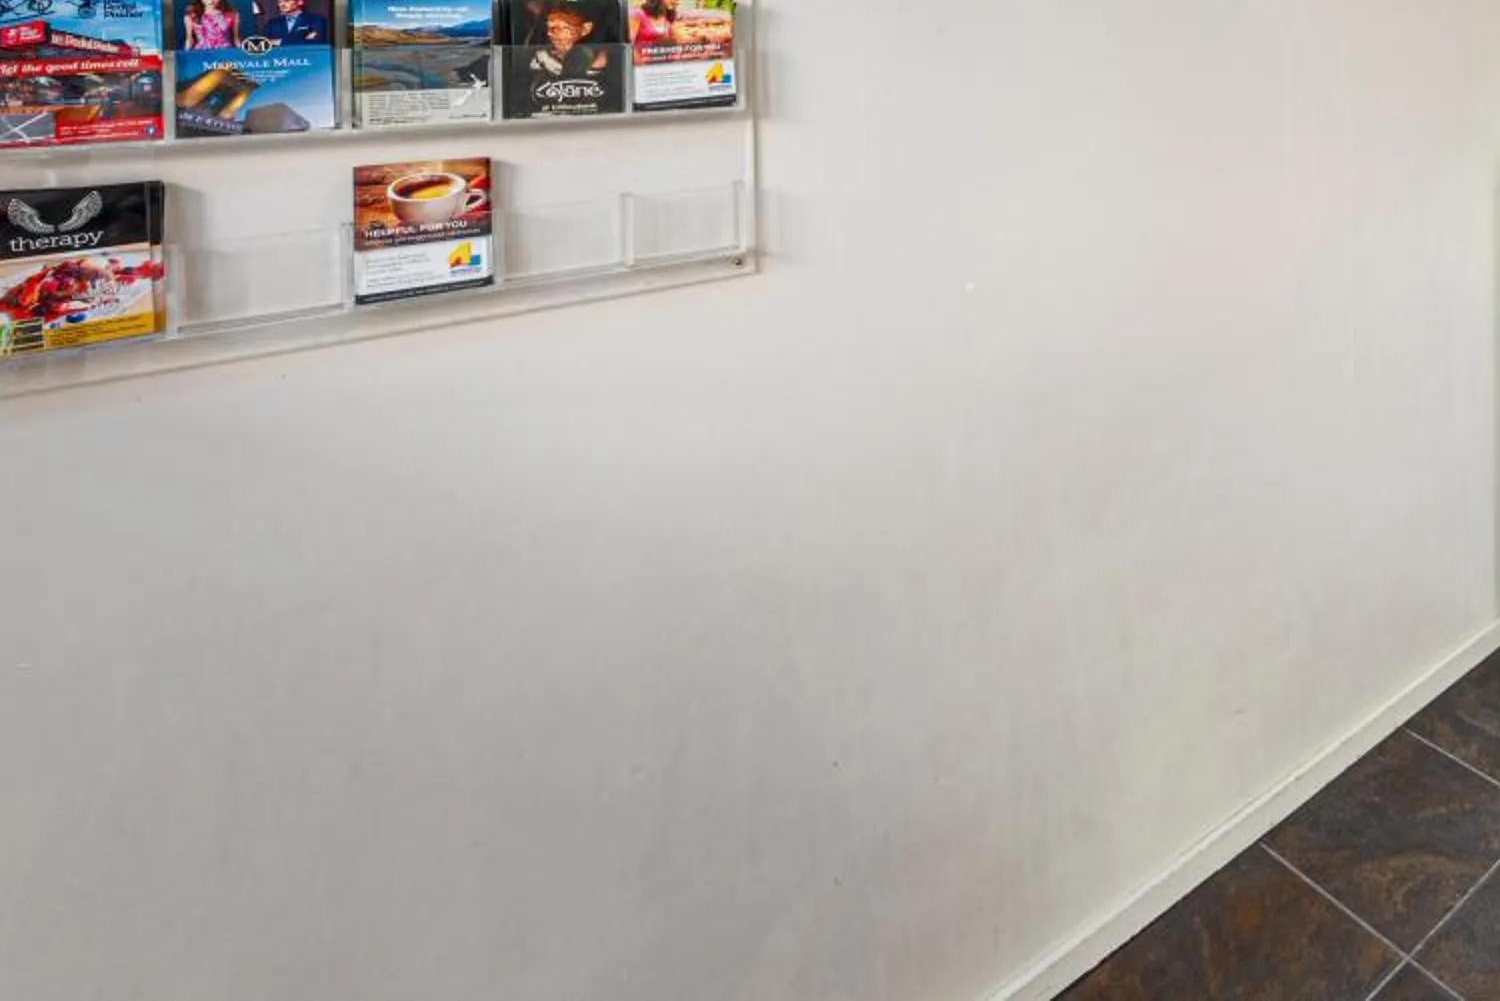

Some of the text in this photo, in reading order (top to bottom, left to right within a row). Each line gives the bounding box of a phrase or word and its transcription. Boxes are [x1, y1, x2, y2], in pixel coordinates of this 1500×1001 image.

[247, 40, 267, 52] M
[273, 58, 312, 67] MALL
[10, 230, 105, 252] therapy
